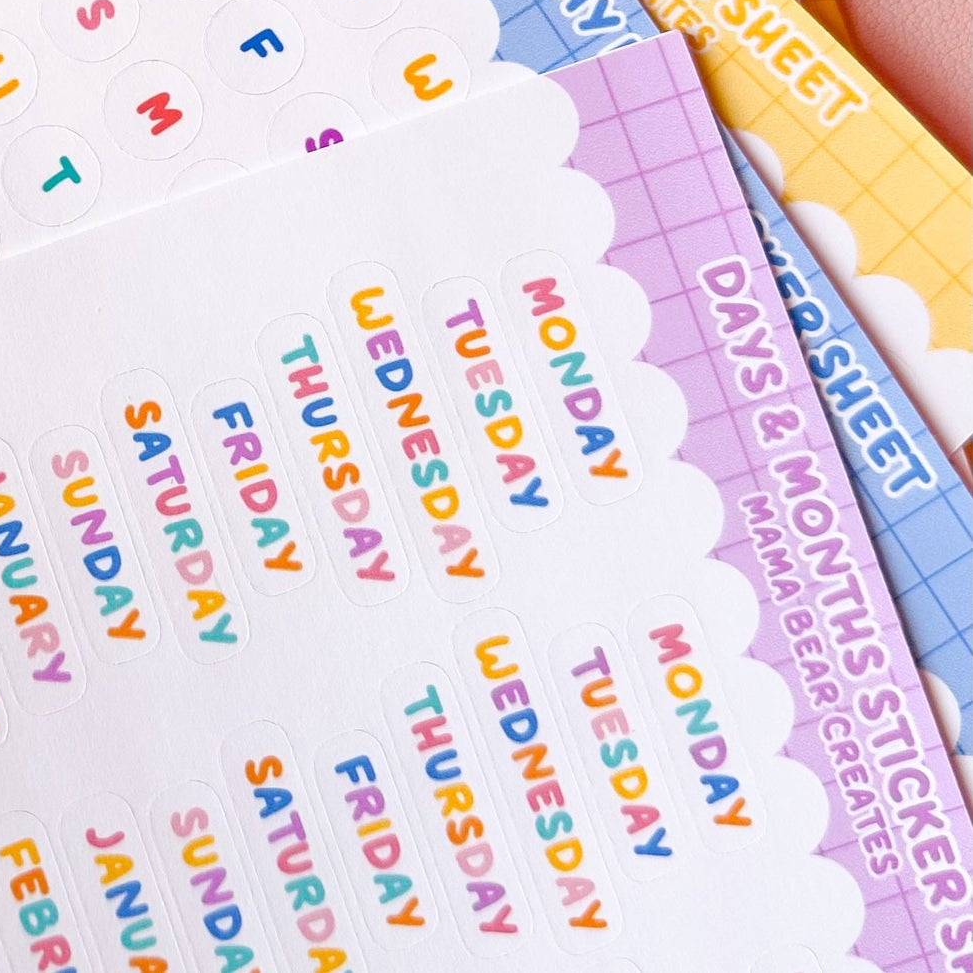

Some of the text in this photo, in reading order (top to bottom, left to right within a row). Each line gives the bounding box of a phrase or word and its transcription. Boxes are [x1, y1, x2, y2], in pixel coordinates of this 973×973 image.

[77, 0, 115, 30] S
[136, 92, 183, 136] M
[240, 28, 284, 58] F
[403, 53, 454, 102] W
[42, 156, 81, 192] T
[447, 299, 548, 507] TUESDAY
[523, 278, 628, 479] MONDAY
[703, 262, 783, 393] DAYS
[757, 408, 800, 443] &
[809, 344, 932, 494] SHEET
[124, 400, 237, 643] SATURDAY
[213, 402, 303, 572] FRIDAY
[282, 335, 395, 581] THURSDAY
[350, 286, 485, 578] WEDNESDAY
[52, 450, 146, 640] SUNDAY
[774, 454, 885, 677] MONTHS
[475, 636, 608, 929] WEDNESDAY
[572, 646, 673, 859] TUESDAY
[650, 625, 752, 827] MONDAY
[744, 495, 900, 876] MAMA BEAR CREATES
[171, 807, 260, 973] SUNDA
[245, 756, 350, 973] SATURDA
[335, 756, 425, 927] FRIDAY
[405, 686, 517, 934] THURSDAY
[857, 688, 967, 906] STICKER
